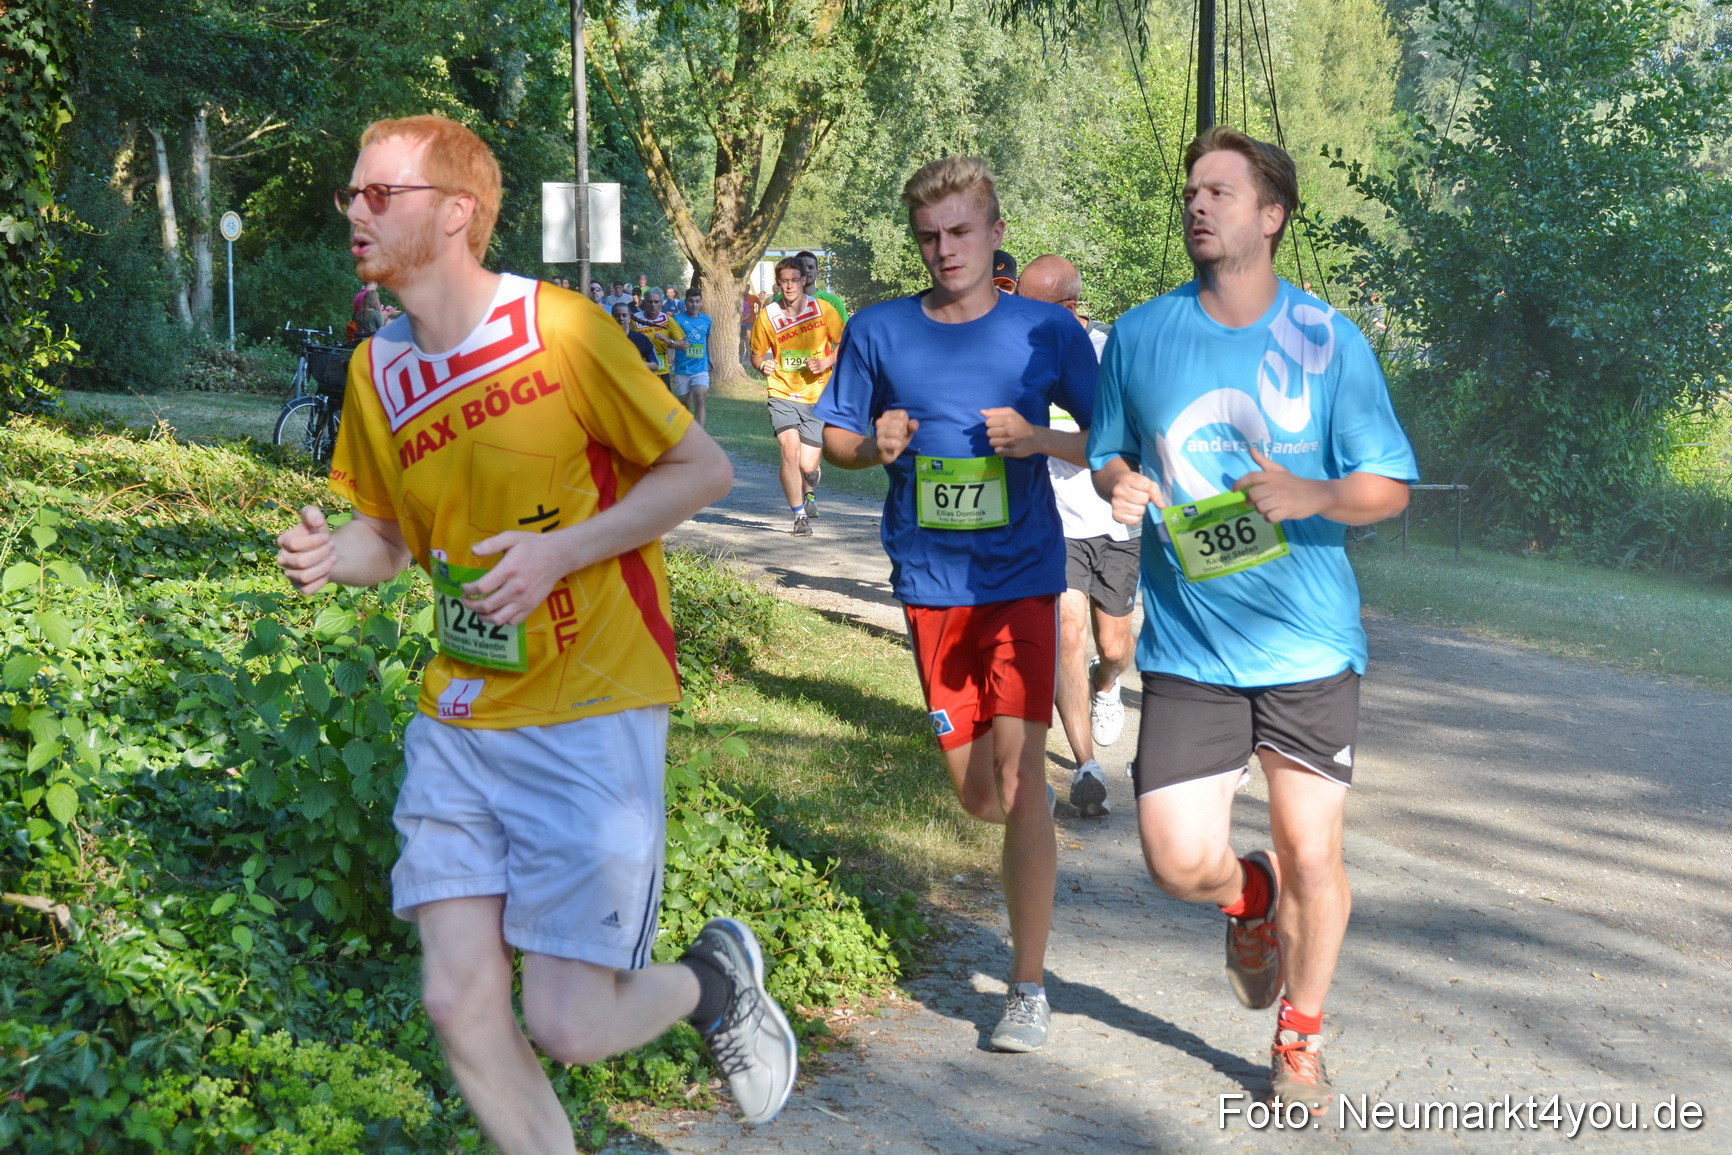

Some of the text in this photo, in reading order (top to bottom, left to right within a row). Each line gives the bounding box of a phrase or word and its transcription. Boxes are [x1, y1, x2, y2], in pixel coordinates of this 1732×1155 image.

[777, 320, 826, 344] MAX BÖGL
[398, 370, 561, 470] MAX BÖGL
[1187, 436, 1247, 452] anders
[1272, 438, 1319, 454] andere
[934, 483, 985, 509] 677
[956, 509, 987, 517] Dominik
[1194, 516, 1257, 557] 386
[1231, 545, 1258, 558] Stefan
[474, 638, 506, 652] Valentin
